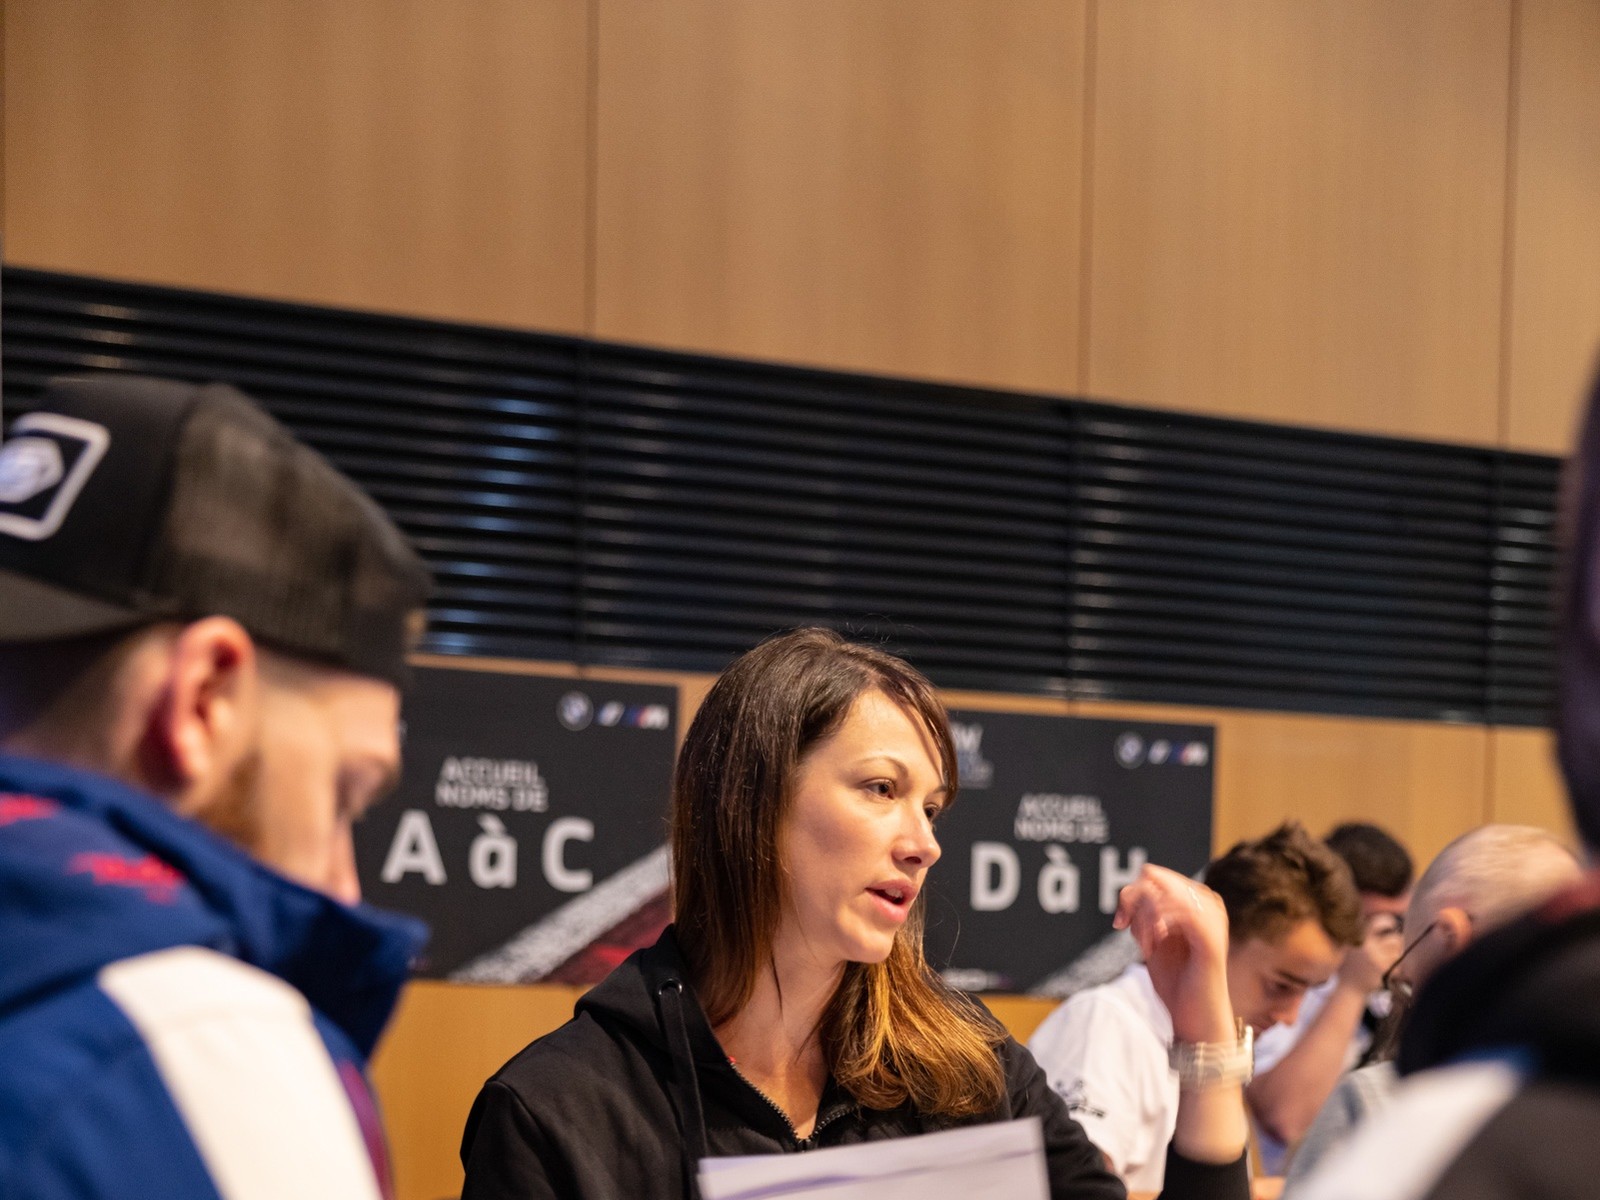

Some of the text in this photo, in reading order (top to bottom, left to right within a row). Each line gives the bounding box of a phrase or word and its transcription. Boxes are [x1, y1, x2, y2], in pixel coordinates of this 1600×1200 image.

[381, 809, 595, 892] A à C
[970, 841, 1149, 914] D à H
